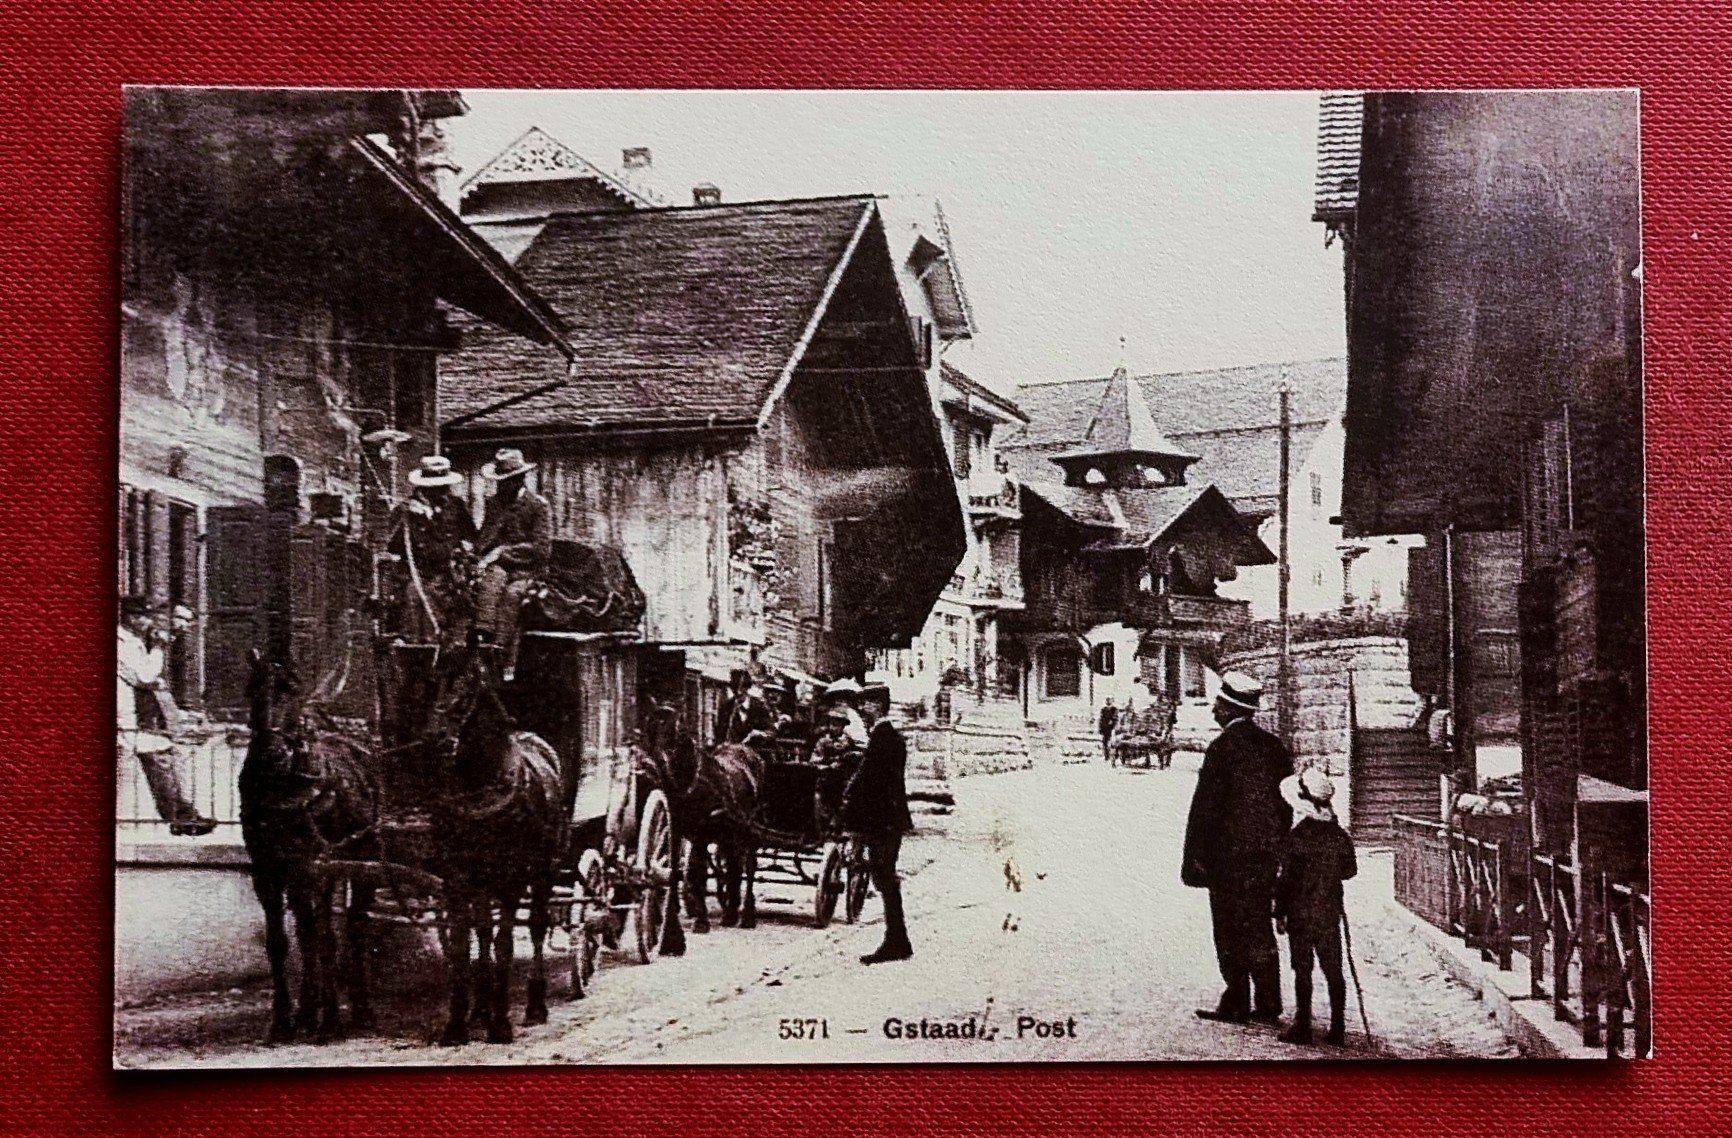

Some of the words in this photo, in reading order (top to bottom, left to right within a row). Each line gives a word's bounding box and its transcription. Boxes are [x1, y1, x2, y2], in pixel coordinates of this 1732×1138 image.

[779, 1018, 830, 1040] 5371
[883, 1016, 976, 1040] Gstaad
[1016, 1016, 1078, 1040] Post
